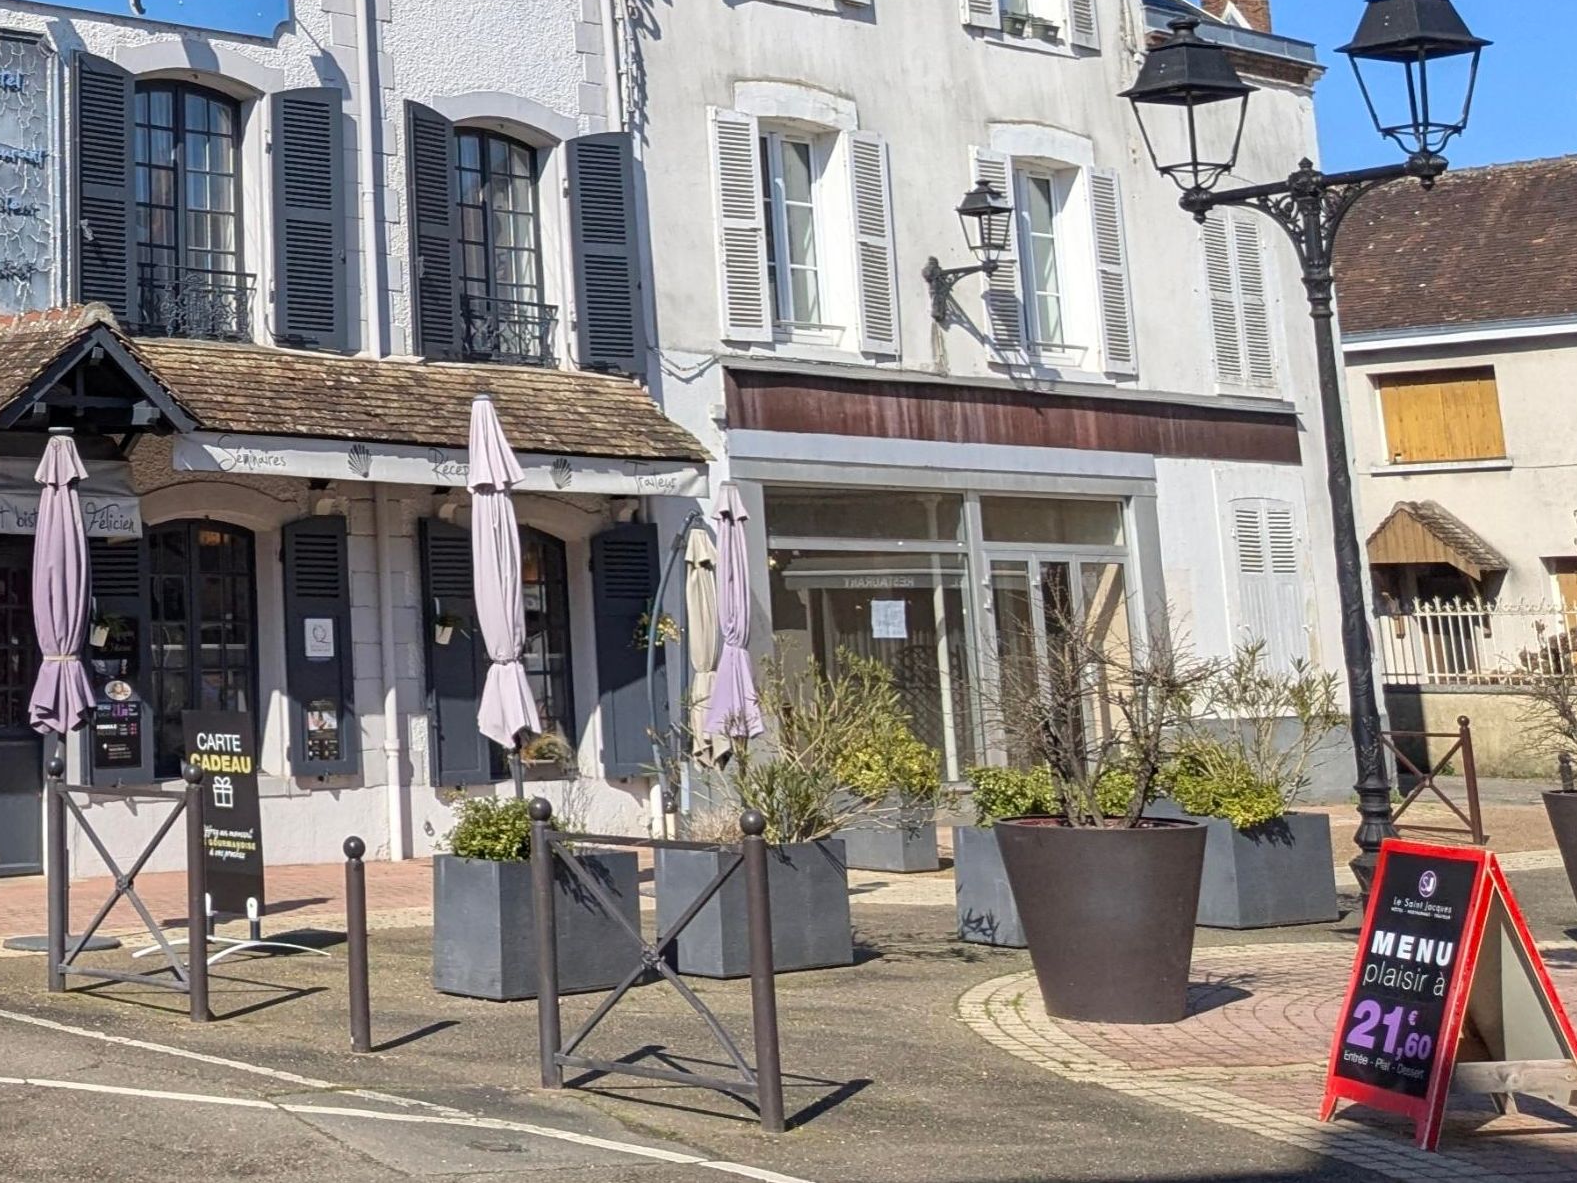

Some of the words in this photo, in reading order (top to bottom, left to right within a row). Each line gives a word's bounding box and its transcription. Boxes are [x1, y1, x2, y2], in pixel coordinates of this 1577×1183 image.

[217, 434, 287, 471] Séminaires
[428, 447, 469, 486] Récep
[624, 460, 677, 493] Traiteur
[85, 502, 136, 533] Félicien
[196, 732, 242, 752] CARTE
[190, 753, 252, 773] CADEAU
[1393, 896, 1402, 906] Le
[1404, 897, 1423, 909] Saint
[1424, 901, 1452, 914] Jacques
[1371, 929, 1454, 967] MENU
[1362, 960, 1429, 992] plaisir
[1433, 972, 1448, 997] à
[1343, 1049, 1369, 1065] Entrée
